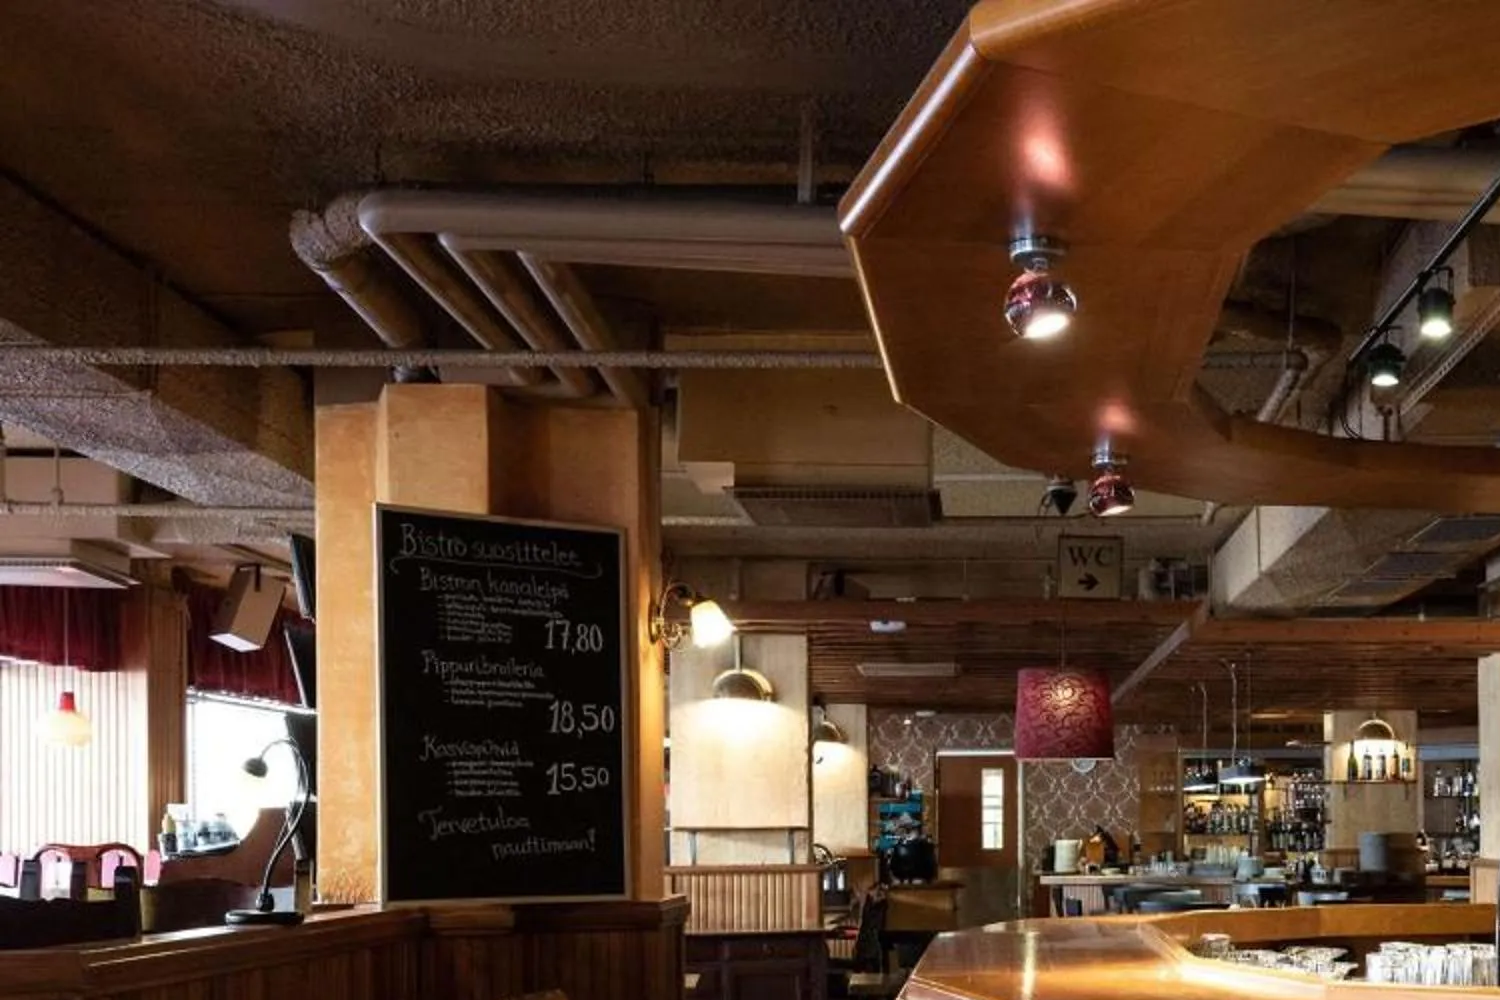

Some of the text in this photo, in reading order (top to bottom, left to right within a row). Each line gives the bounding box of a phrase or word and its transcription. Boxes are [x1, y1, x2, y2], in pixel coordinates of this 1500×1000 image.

[400, 523, 581, 566] Bistro suosittelee
[1068, 546, 1115, 567] WC
[419, 566, 484, 594] Bistron
[544, 618, 604, 656] 17,80
[548, 699, 615, 739] 18,50
[418, 806, 530, 840] Tervetuloa
[491, 829, 596, 859] nauttimaan!
